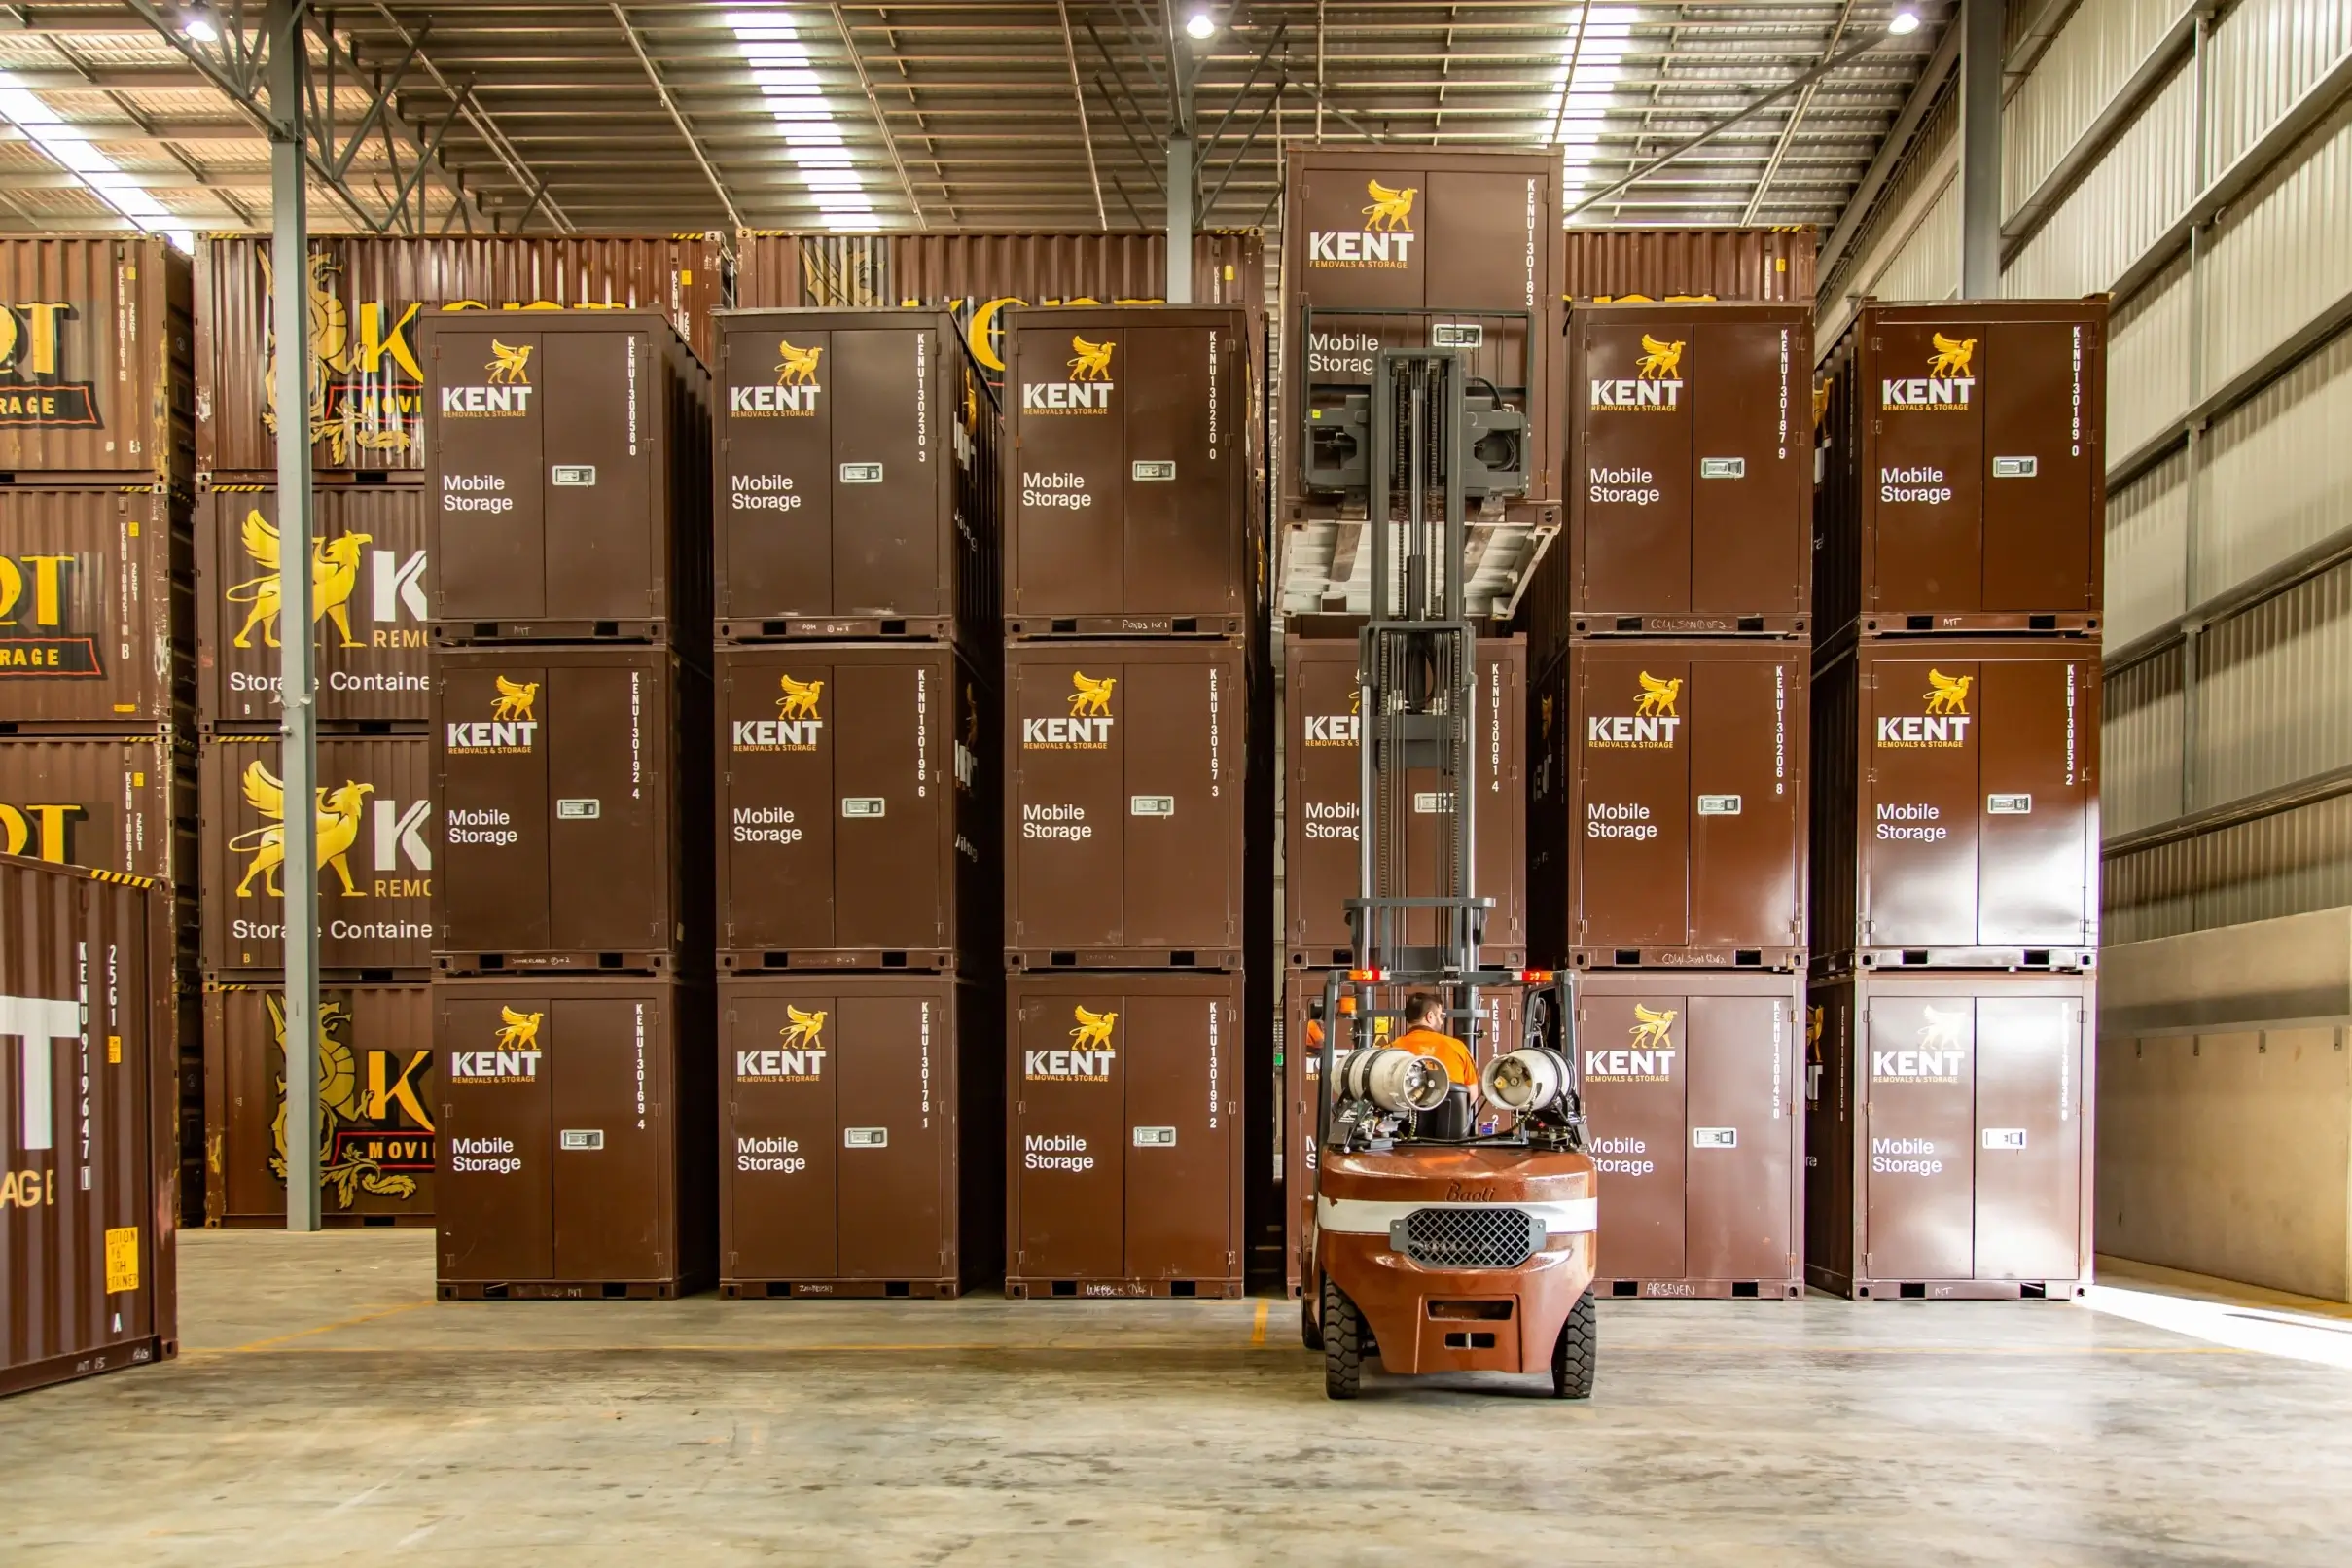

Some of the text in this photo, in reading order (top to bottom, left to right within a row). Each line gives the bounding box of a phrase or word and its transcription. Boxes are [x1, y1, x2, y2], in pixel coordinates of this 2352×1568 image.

[1310, 232, 1414, 261] KENT
[1526, 178, 1535, 307] KENU130183
[1368, 261, 1408, 269] STORAGE
[1309, 333, 1378, 351] Mobile
[1309, 354, 1373, 375] Storag
[443, 387, 532, 411] KENT
[731, 386, 820, 410] KENT
[1023, 383, 1113, 408] KENT
[1591, 380, 1683, 405] KENT
[1779, 330, 1788, 459] KENU130187 9
[1883, 378, 1975, 404] KENT
[630, 445, 635, 455] 0
[919, 451, 925, 462] 3
[1210, 449, 1216, 459] 0
[2073, 445, 2079, 456] 0
[445, 475, 504, 490] Mobile
[732, 475, 793, 490] Mobile
[1024, 473, 1084, 488] Mobile
[1591, 468, 1652, 483] Mobile
[1882, 467, 1942, 483] Mobile
[732, 493, 801, 511] Storage
[1023, 490, 1091, 510] Storage
[1590, 486, 1659, 505] Storage
[1881, 486, 1950, 504] Storage
[445, 495, 512, 514] Storage
[1943, 618, 1962, 627] MT
[374, 630, 428, 648] REM
[0, 648, 58, 666] RAGE
[122, 643, 129, 659] B
[230, 672, 319, 691] Storae
[244, 704, 250, 714] B
[448, 722, 537, 746] KENT
[733, 721, 822, 744] KENT
[1024, 718, 1113, 742] KENT
[1589, 717, 1680, 741] KENT
[1878, 717, 1970, 740] KENT
[1491, 781, 1499, 792] 4
[2066, 774, 2073, 785] 2
[633, 789, 639, 799] 4
[919, 786, 925, 797] 6
[1212, 786, 1218, 796] 3
[1776, 783, 1783, 794] 8
[449, 809, 509, 825] Mobile
[734, 807, 794, 823] Mobile
[1024, 804, 1084, 820] Mobile
[1305, 802, 1359, 819] Mobil
[1589, 803, 1649, 819] Mobile
[1877, 804, 1939, 819] Mobile
[449, 828, 517, 845] Storage
[734, 827, 802, 844] Storage
[1024, 823, 1091, 840] Storage
[1305, 823, 1359, 841] Storag
[1588, 822, 1657, 840] Storage
[1877, 824, 1946, 842] Storage
[232, 920, 321, 939] Storae
[243, 953, 250, 963] B
[79, 942, 88, 1025] KENU
[452, 1052, 541, 1076] KENT
[737, 1051, 826, 1075] KENT
[1026, 1051, 1115, 1075] KENT
[1586, 1051, 1675, 1074] KENT
[1873, 1051, 1965, 1076] KENT
[81, 1032, 89, 1159] 919647
[1774, 1108, 1779, 1119] 0
[638, 1120, 645, 1129] 4
[924, 1118, 927, 1127] 1
[1210, 1118, 1216, 1128] 2
[453, 1138, 513, 1154] Mobile
[738, 1137, 798, 1153] Mobile
[1026, 1135, 1086, 1151] Mobile
[1587, 1137, 1646, 1154] Mobile
[1872, 1138, 1934, 1155] Mobile
[453, 1157, 520, 1173] Storage
[738, 1156, 805, 1173] Storage
[1026, 1153, 1093, 1172] Storage
[1872, 1157, 1942, 1177] Storage
[113, 1313, 122, 1333] A
